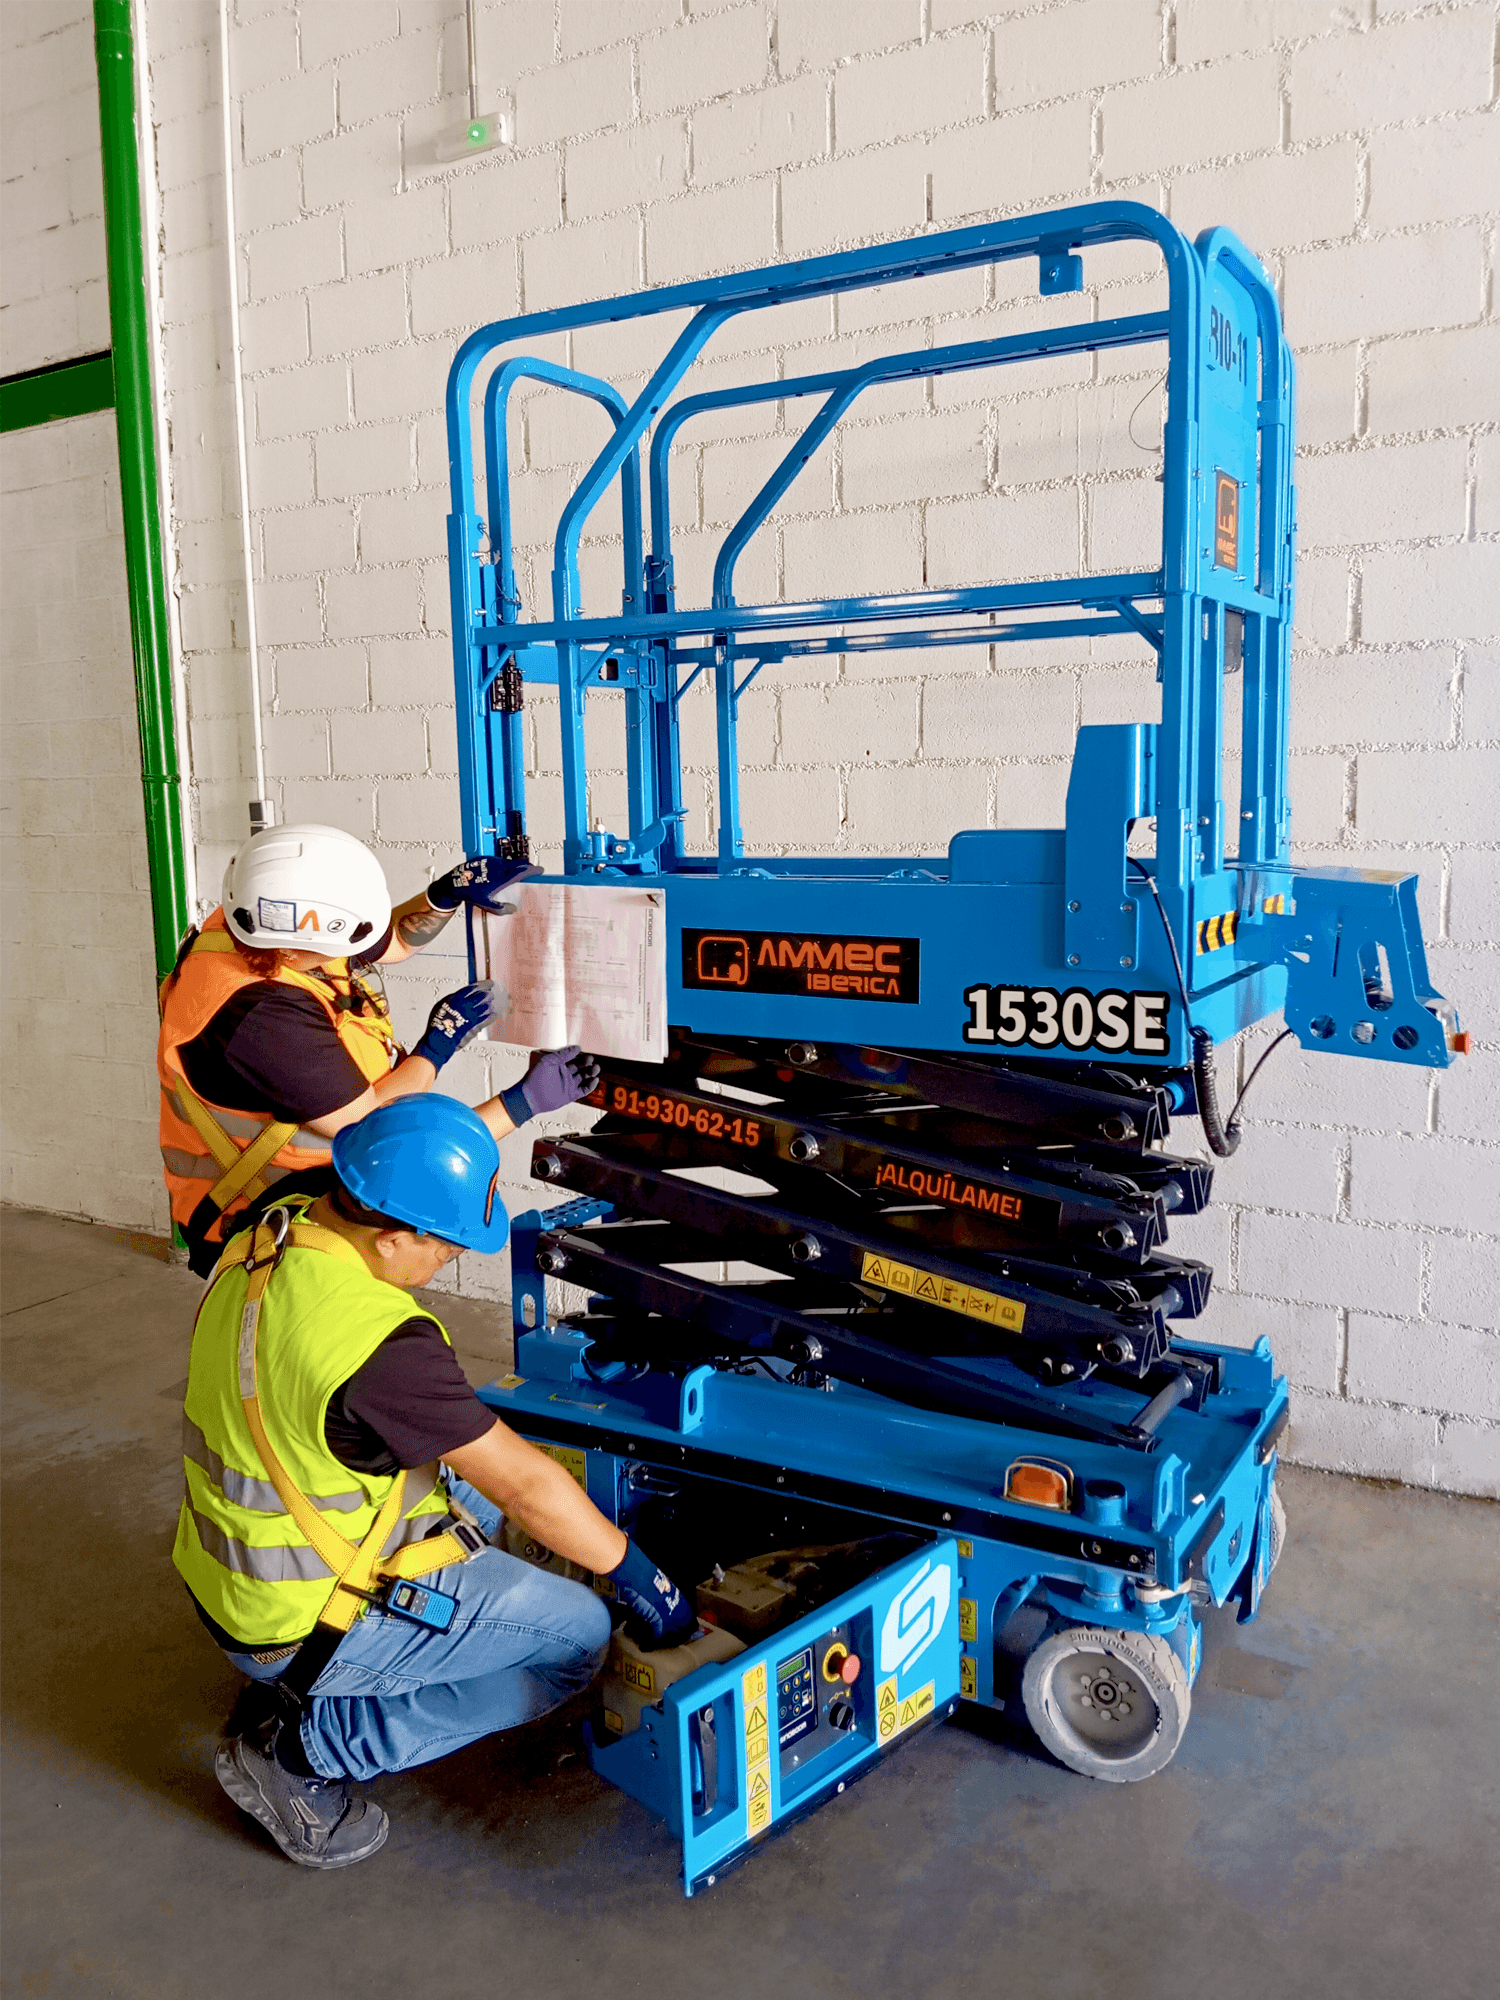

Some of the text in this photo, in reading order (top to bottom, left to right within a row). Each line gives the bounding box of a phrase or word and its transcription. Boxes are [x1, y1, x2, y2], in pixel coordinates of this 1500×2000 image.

[330, 920, 341, 931] 2
[757, 939, 900, 974] AMMEC
[807, 973, 900, 996] IBERICA
[966, 988, 1166, 1052] 1530SE
[614, 1086, 761, 1147] 91-930-62-15
[875, 1163, 1022, 1220] ¡ALQUÍLAME!
